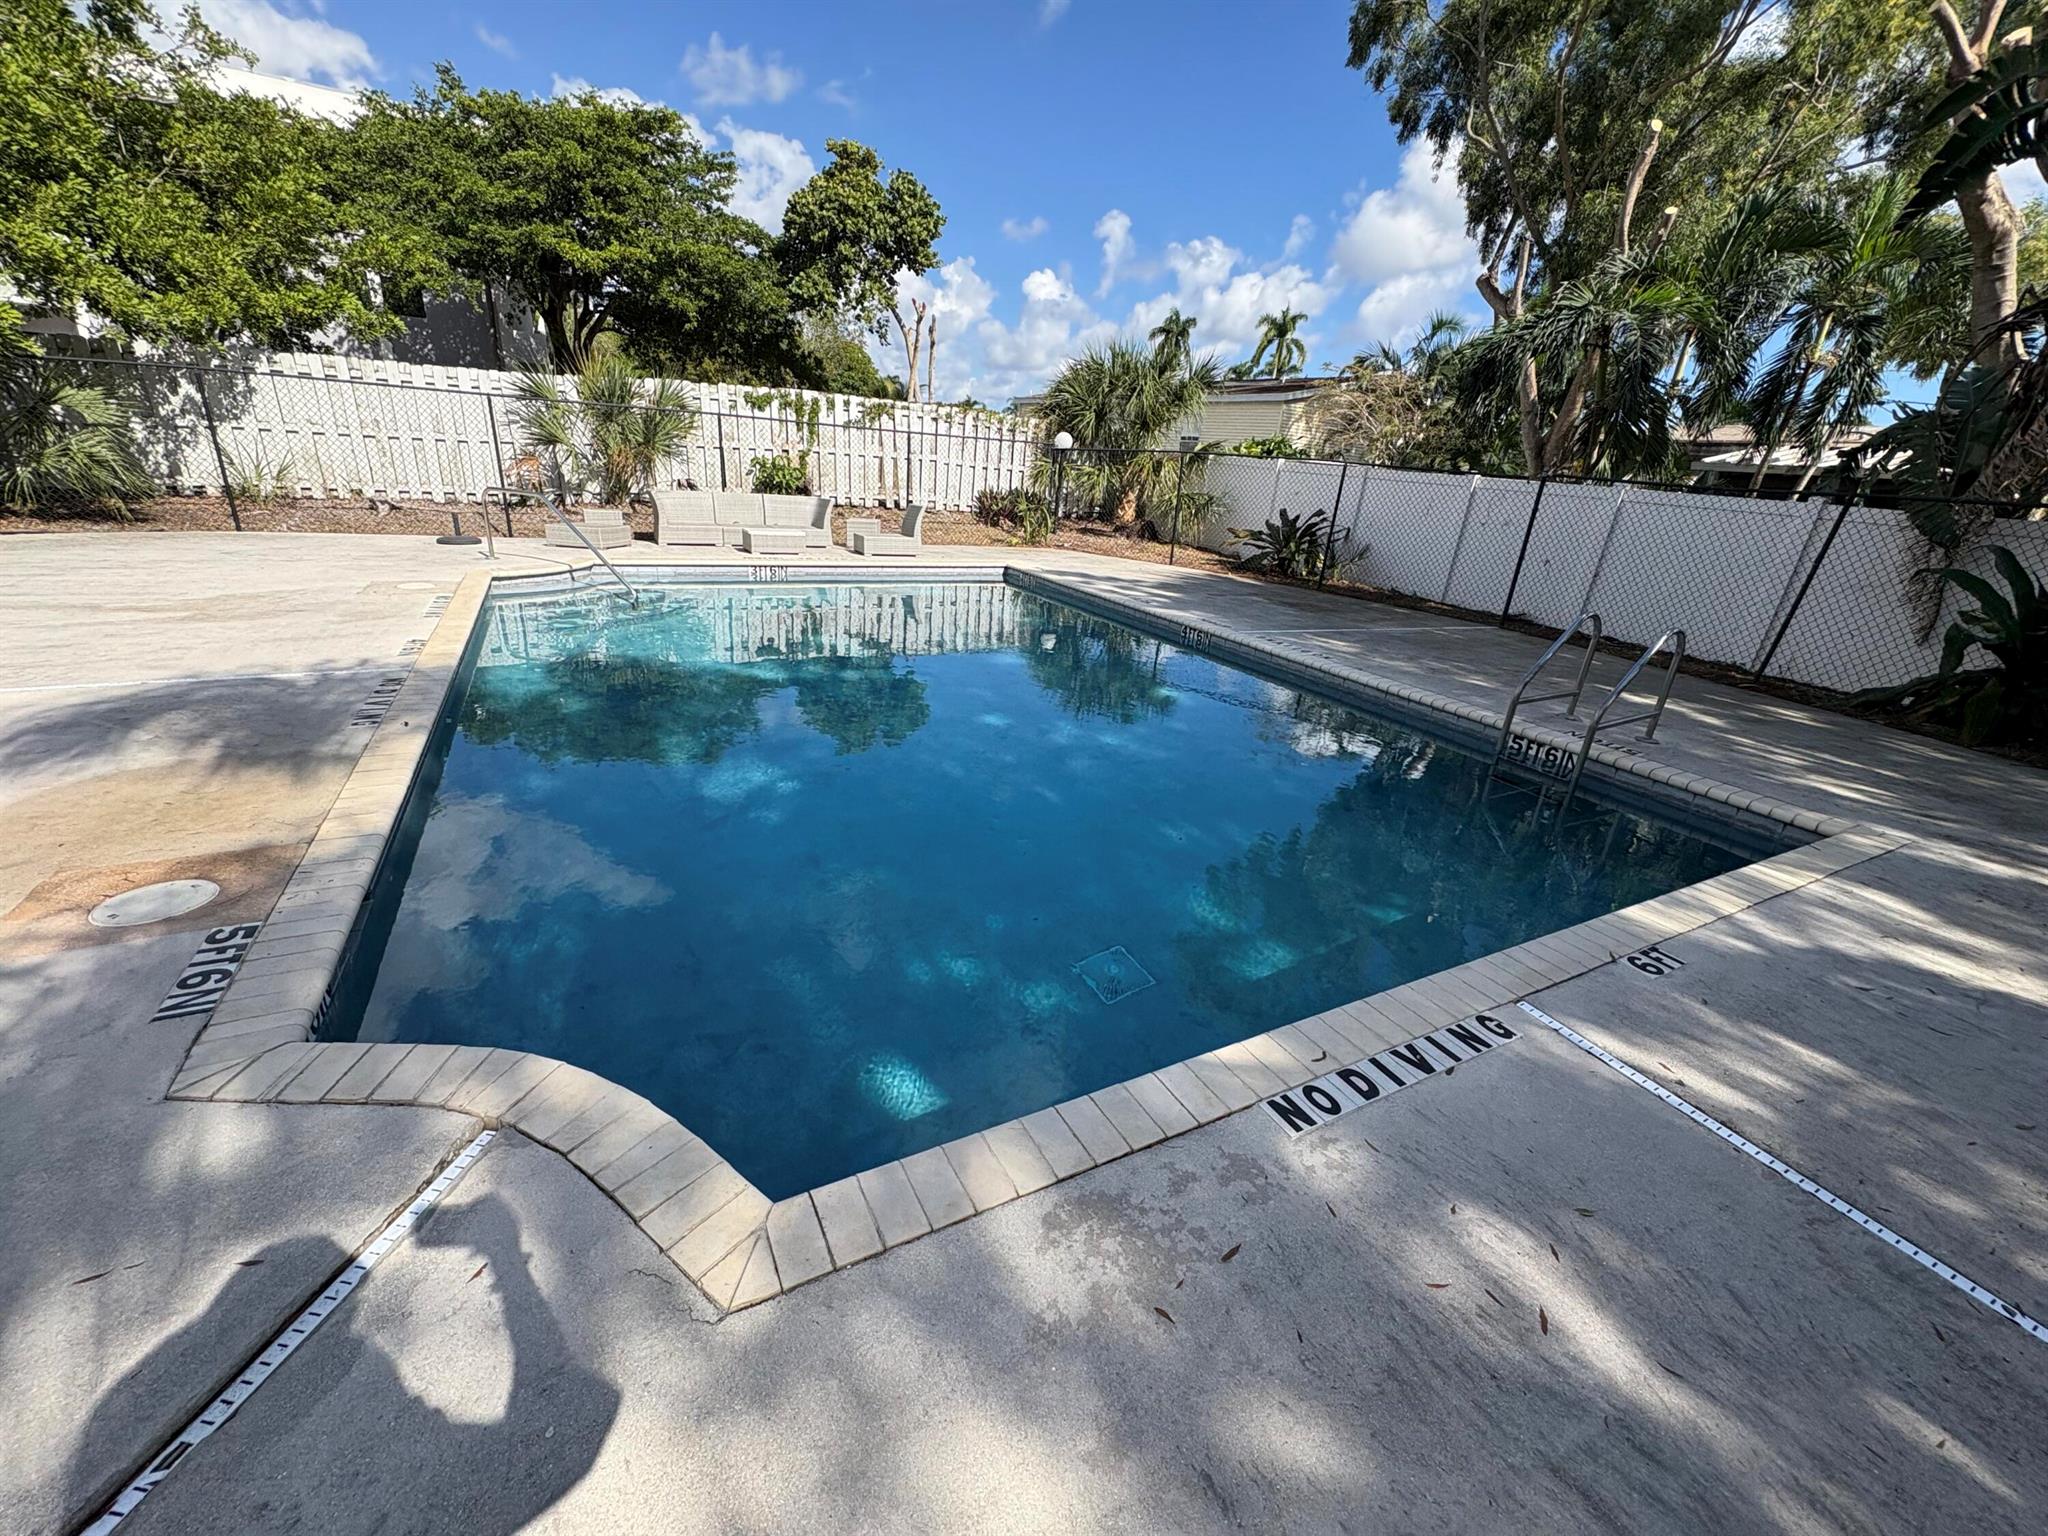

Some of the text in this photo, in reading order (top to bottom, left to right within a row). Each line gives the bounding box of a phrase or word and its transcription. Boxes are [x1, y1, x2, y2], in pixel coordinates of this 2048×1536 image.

[1626, 946, 1685, 977] 6FT
[1267, 1014, 1519, 1133] NO DIVING
